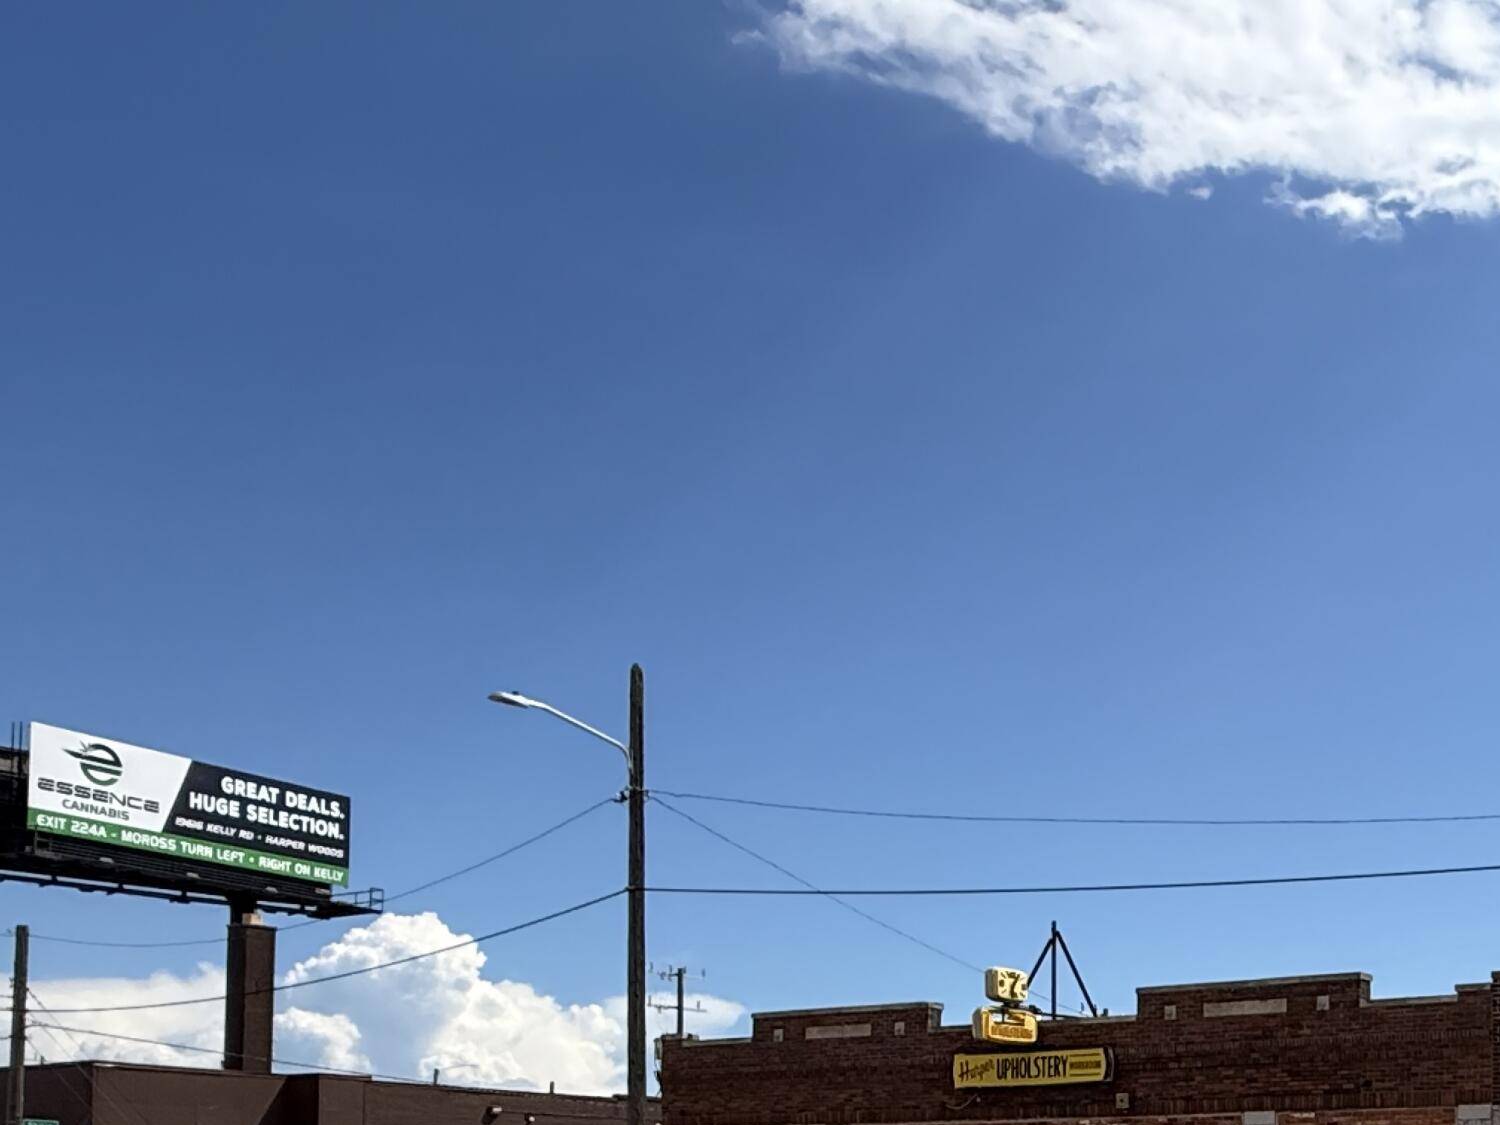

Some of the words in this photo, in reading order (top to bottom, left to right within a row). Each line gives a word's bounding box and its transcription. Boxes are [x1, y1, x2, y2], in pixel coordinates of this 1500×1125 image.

[37, 777, 160, 813] ESSENCE
[62, 798, 130, 821] CANNABIS
[221, 776, 279, 803] GREAT
[285, 791, 345, 819] DEALS.
[189, 791, 240, 818] HUGE
[246, 803, 345, 840] SELECTION.
[36, 814, 67, 829] EXIT
[70, 820, 107, 838] 224A
[121, 830, 177, 850] MOROSS
[181, 841, 213, 858] TURN
[217, 848, 246, 863] LEFT
[258, 856, 292, 872] RIGHT
[294, 864, 311, 876] ON
[314, 868, 344, 882] KELLY
[206, 823, 237, 837] KELLY
[265, 834, 305, 850] HARPER
[996, 1054, 1068, 1080] UPHOLSTERY
